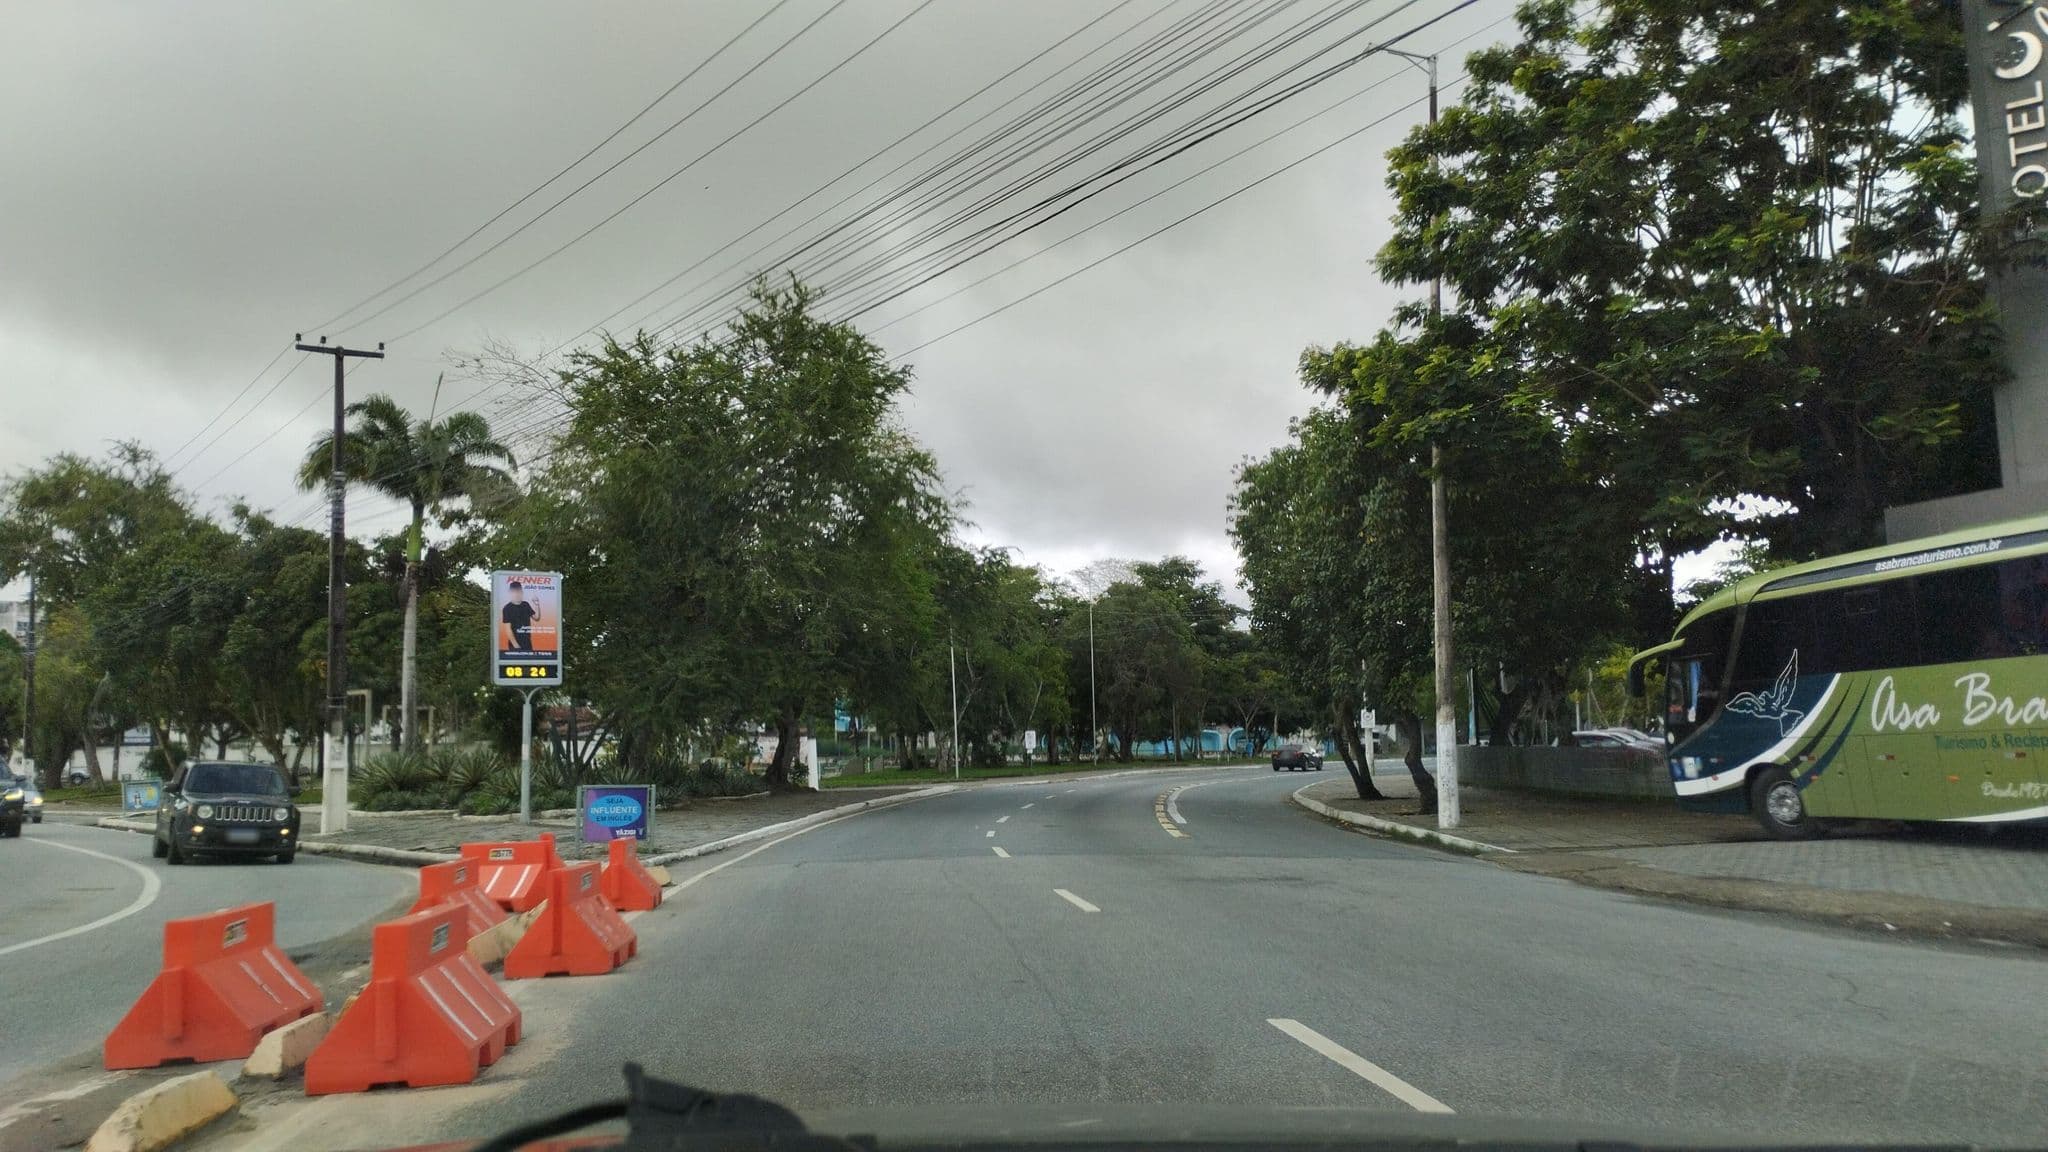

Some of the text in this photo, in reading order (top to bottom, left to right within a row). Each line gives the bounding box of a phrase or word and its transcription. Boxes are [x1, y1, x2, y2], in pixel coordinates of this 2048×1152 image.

[2003, 80, 2048, 198] OTEL
[1875, 538, 2002, 572] asabrancaturismo.com.br
[530, 667, 546, 677] 24
[1871, 672, 2048, 732] Asa Bra
[1934, 735, 1987, 750] Turismo
[590, 806, 638, 814] INFLUENTE
